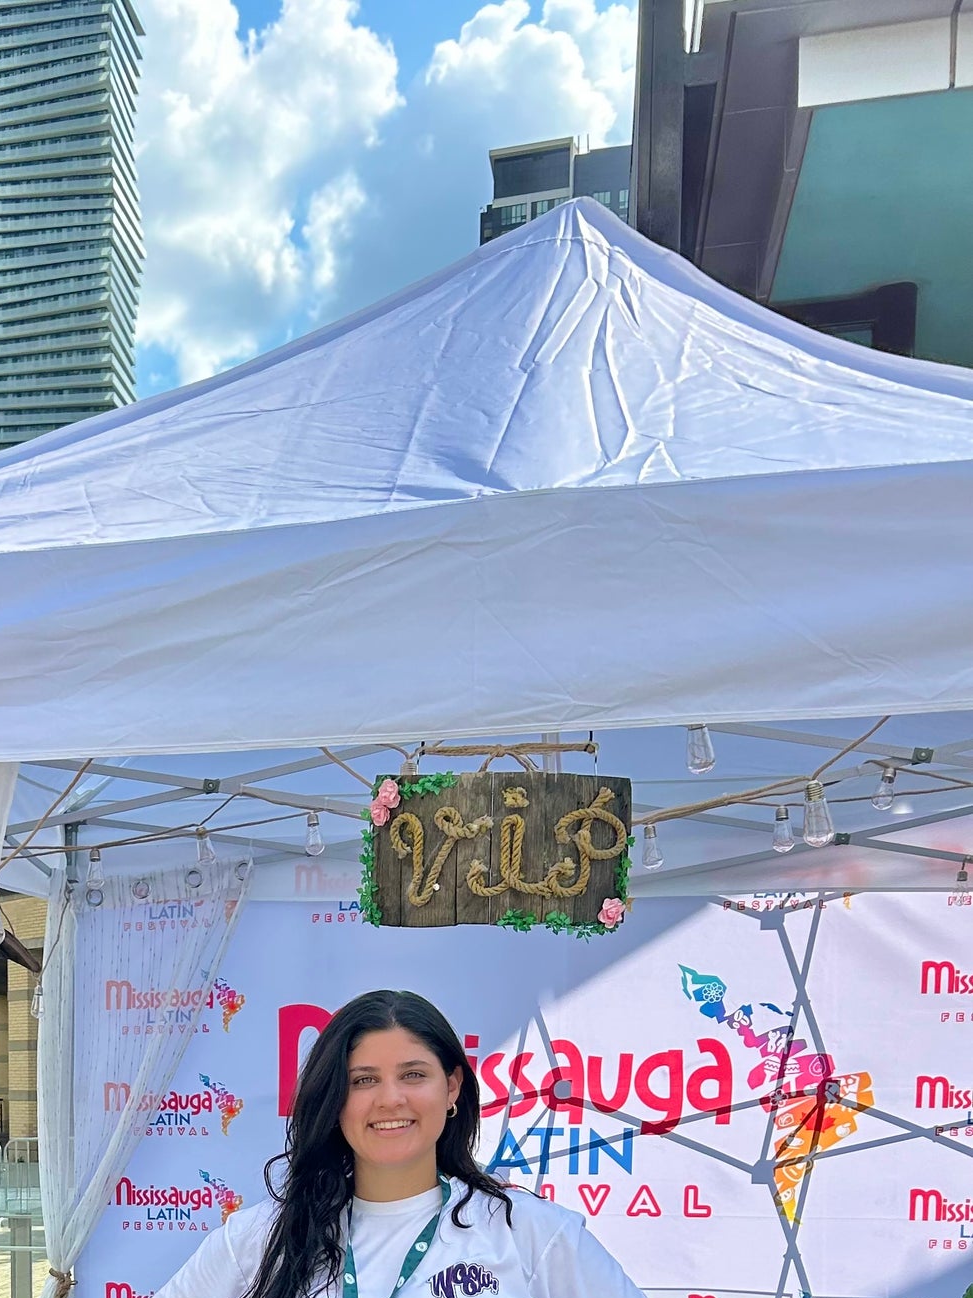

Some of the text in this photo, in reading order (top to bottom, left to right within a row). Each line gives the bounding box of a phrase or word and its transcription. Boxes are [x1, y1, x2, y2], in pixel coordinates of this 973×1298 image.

[723, 899, 827, 911] FESTIVAL
[312, 912, 358, 924] FEST
[146, 1008, 193, 1024] LTIN
[133, 1127, 209, 1136] STIVAL
[485, 1127, 634, 1176] ATIN
[540, 1183, 712, 1218] IVAL
[147, 1208, 191, 1221] LATIN
[122, 1221, 209, 1231] FESTIVAL
